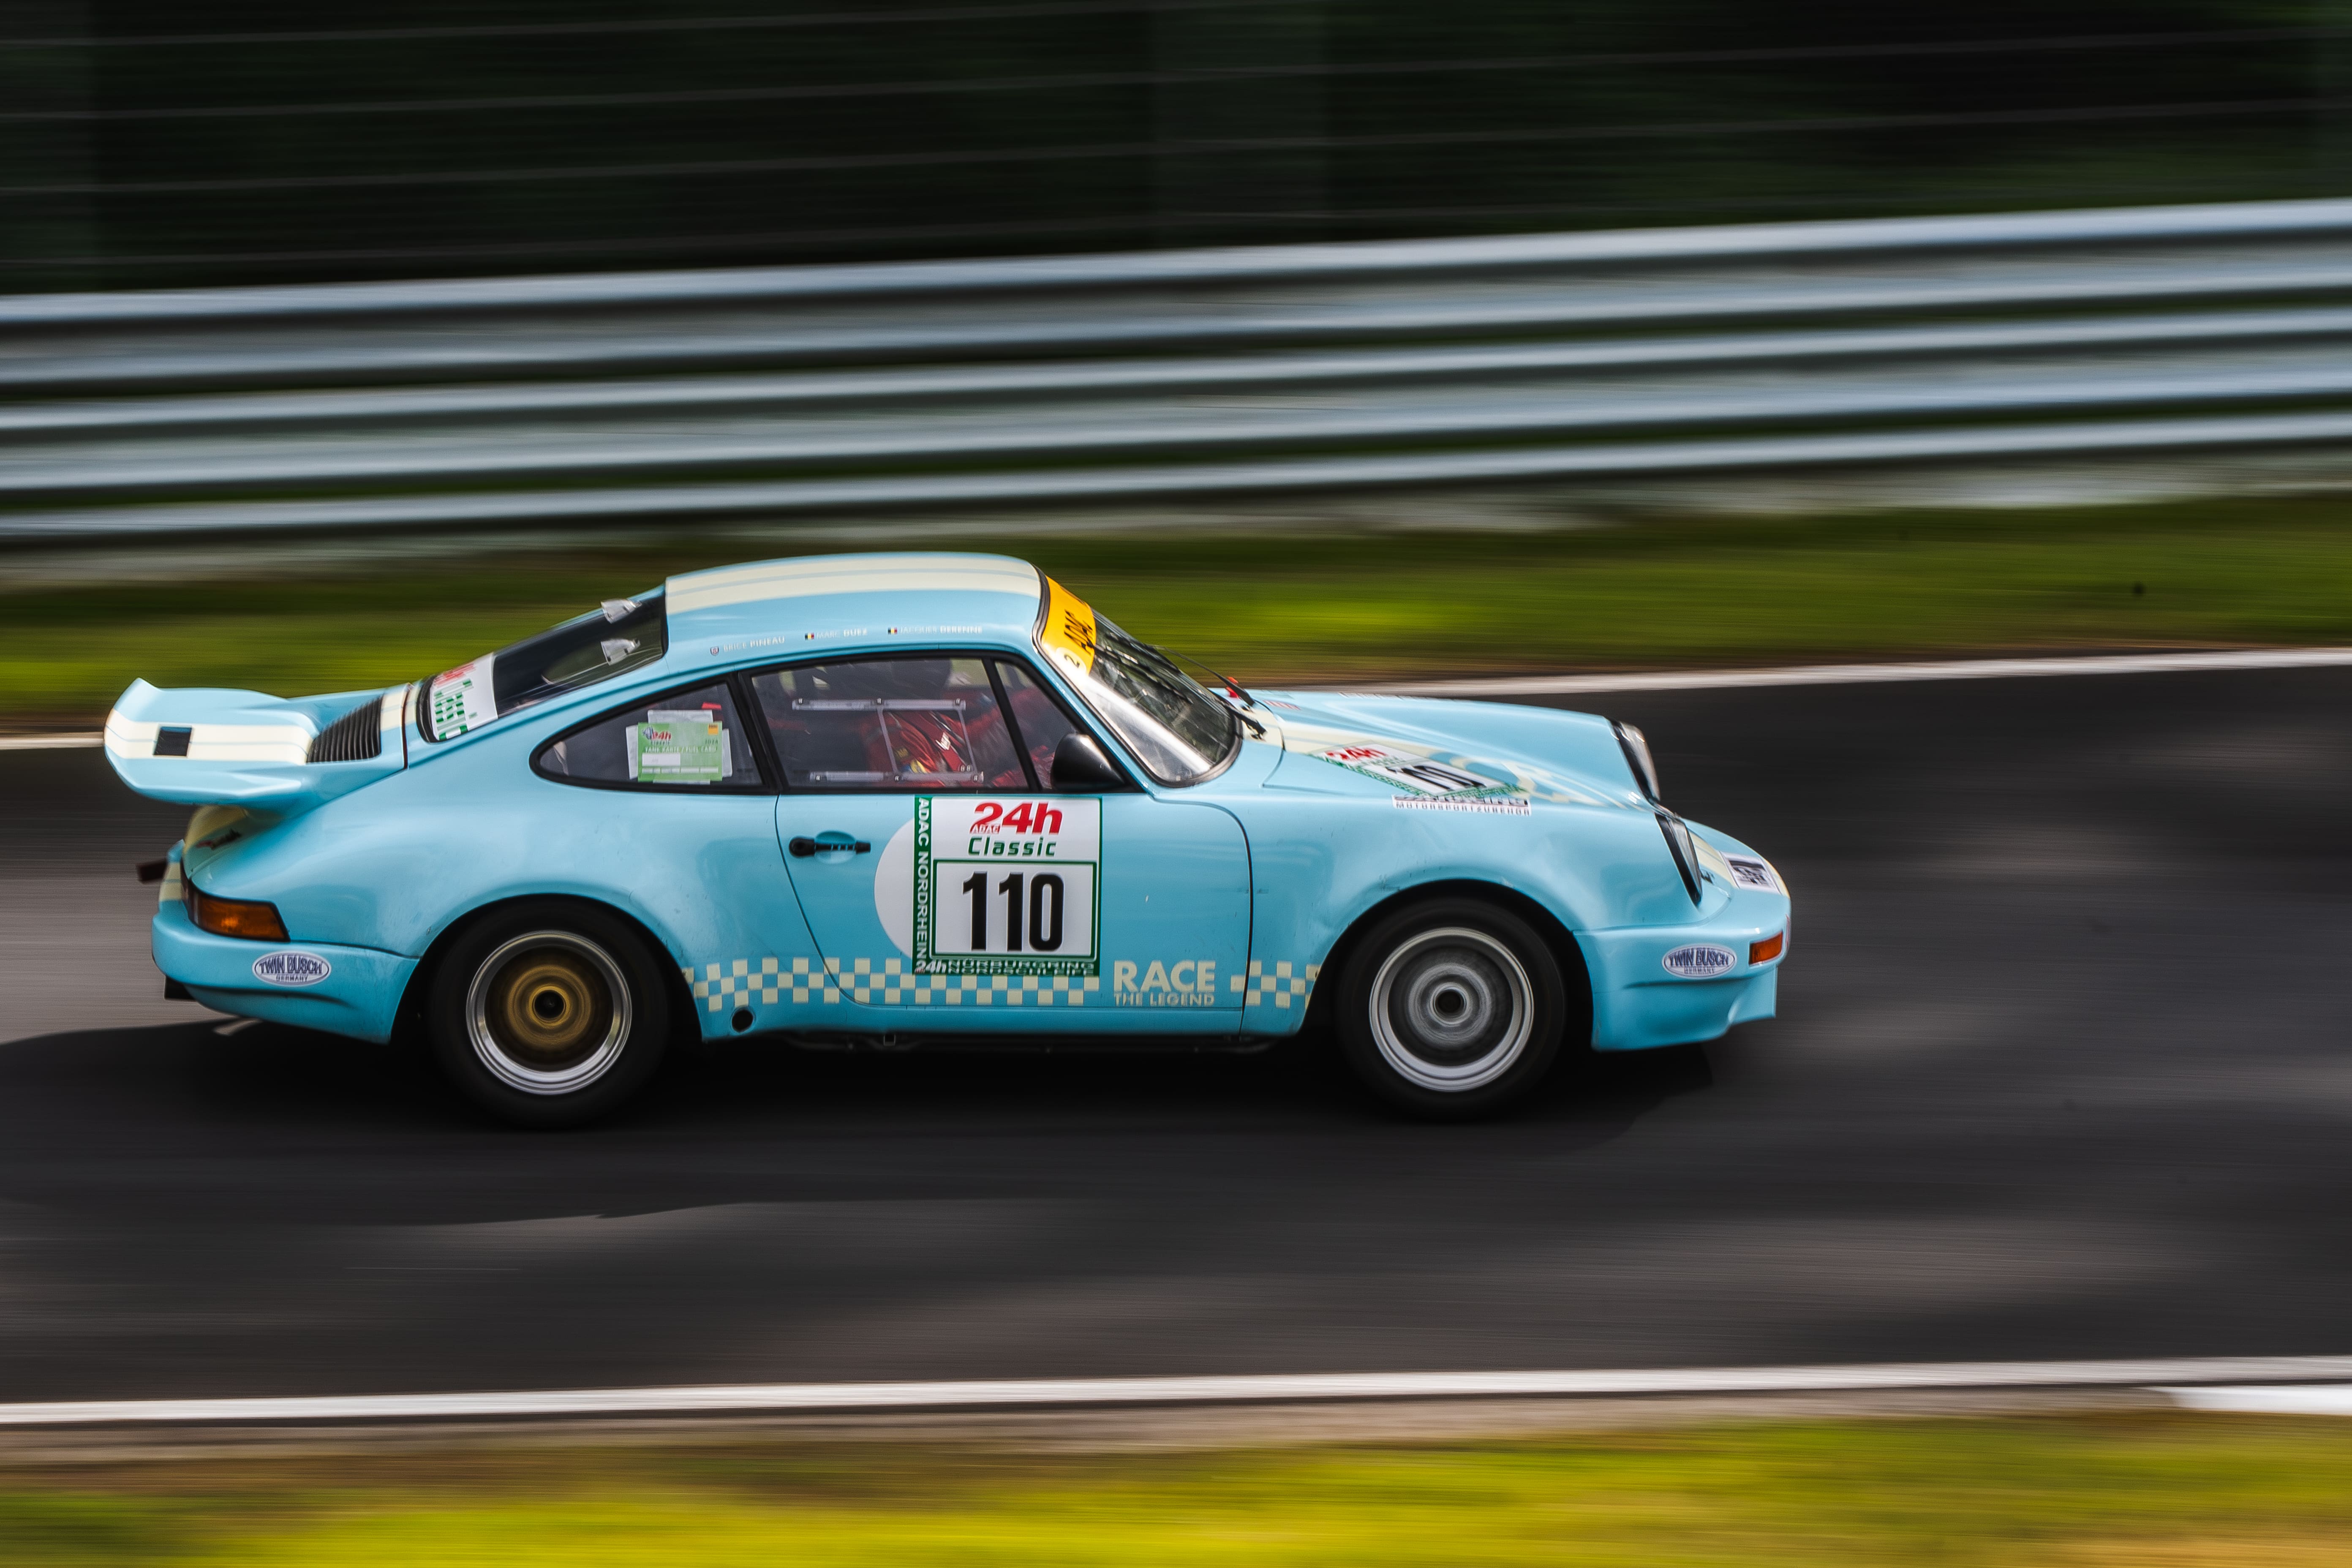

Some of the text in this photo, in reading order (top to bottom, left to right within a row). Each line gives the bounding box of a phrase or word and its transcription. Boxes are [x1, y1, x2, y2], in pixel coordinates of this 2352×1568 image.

[970, 801, 1063, 835] 24h
[971, 824, 1000, 834] ADAC
[968, 836, 1056, 857] Classic
[916, 798, 929, 961] ADAC NORDRHEIN
[963, 871, 1064, 952] 110
[259, 955, 322, 974] TWIN BUSCH
[915, 959, 947, 974] 24h
[1669, 947, 1729, 966] TWIN BUSCH
[1113, 960, 1216, 992] RACE
[1150, 992, 1214, 1007] LEGEND
